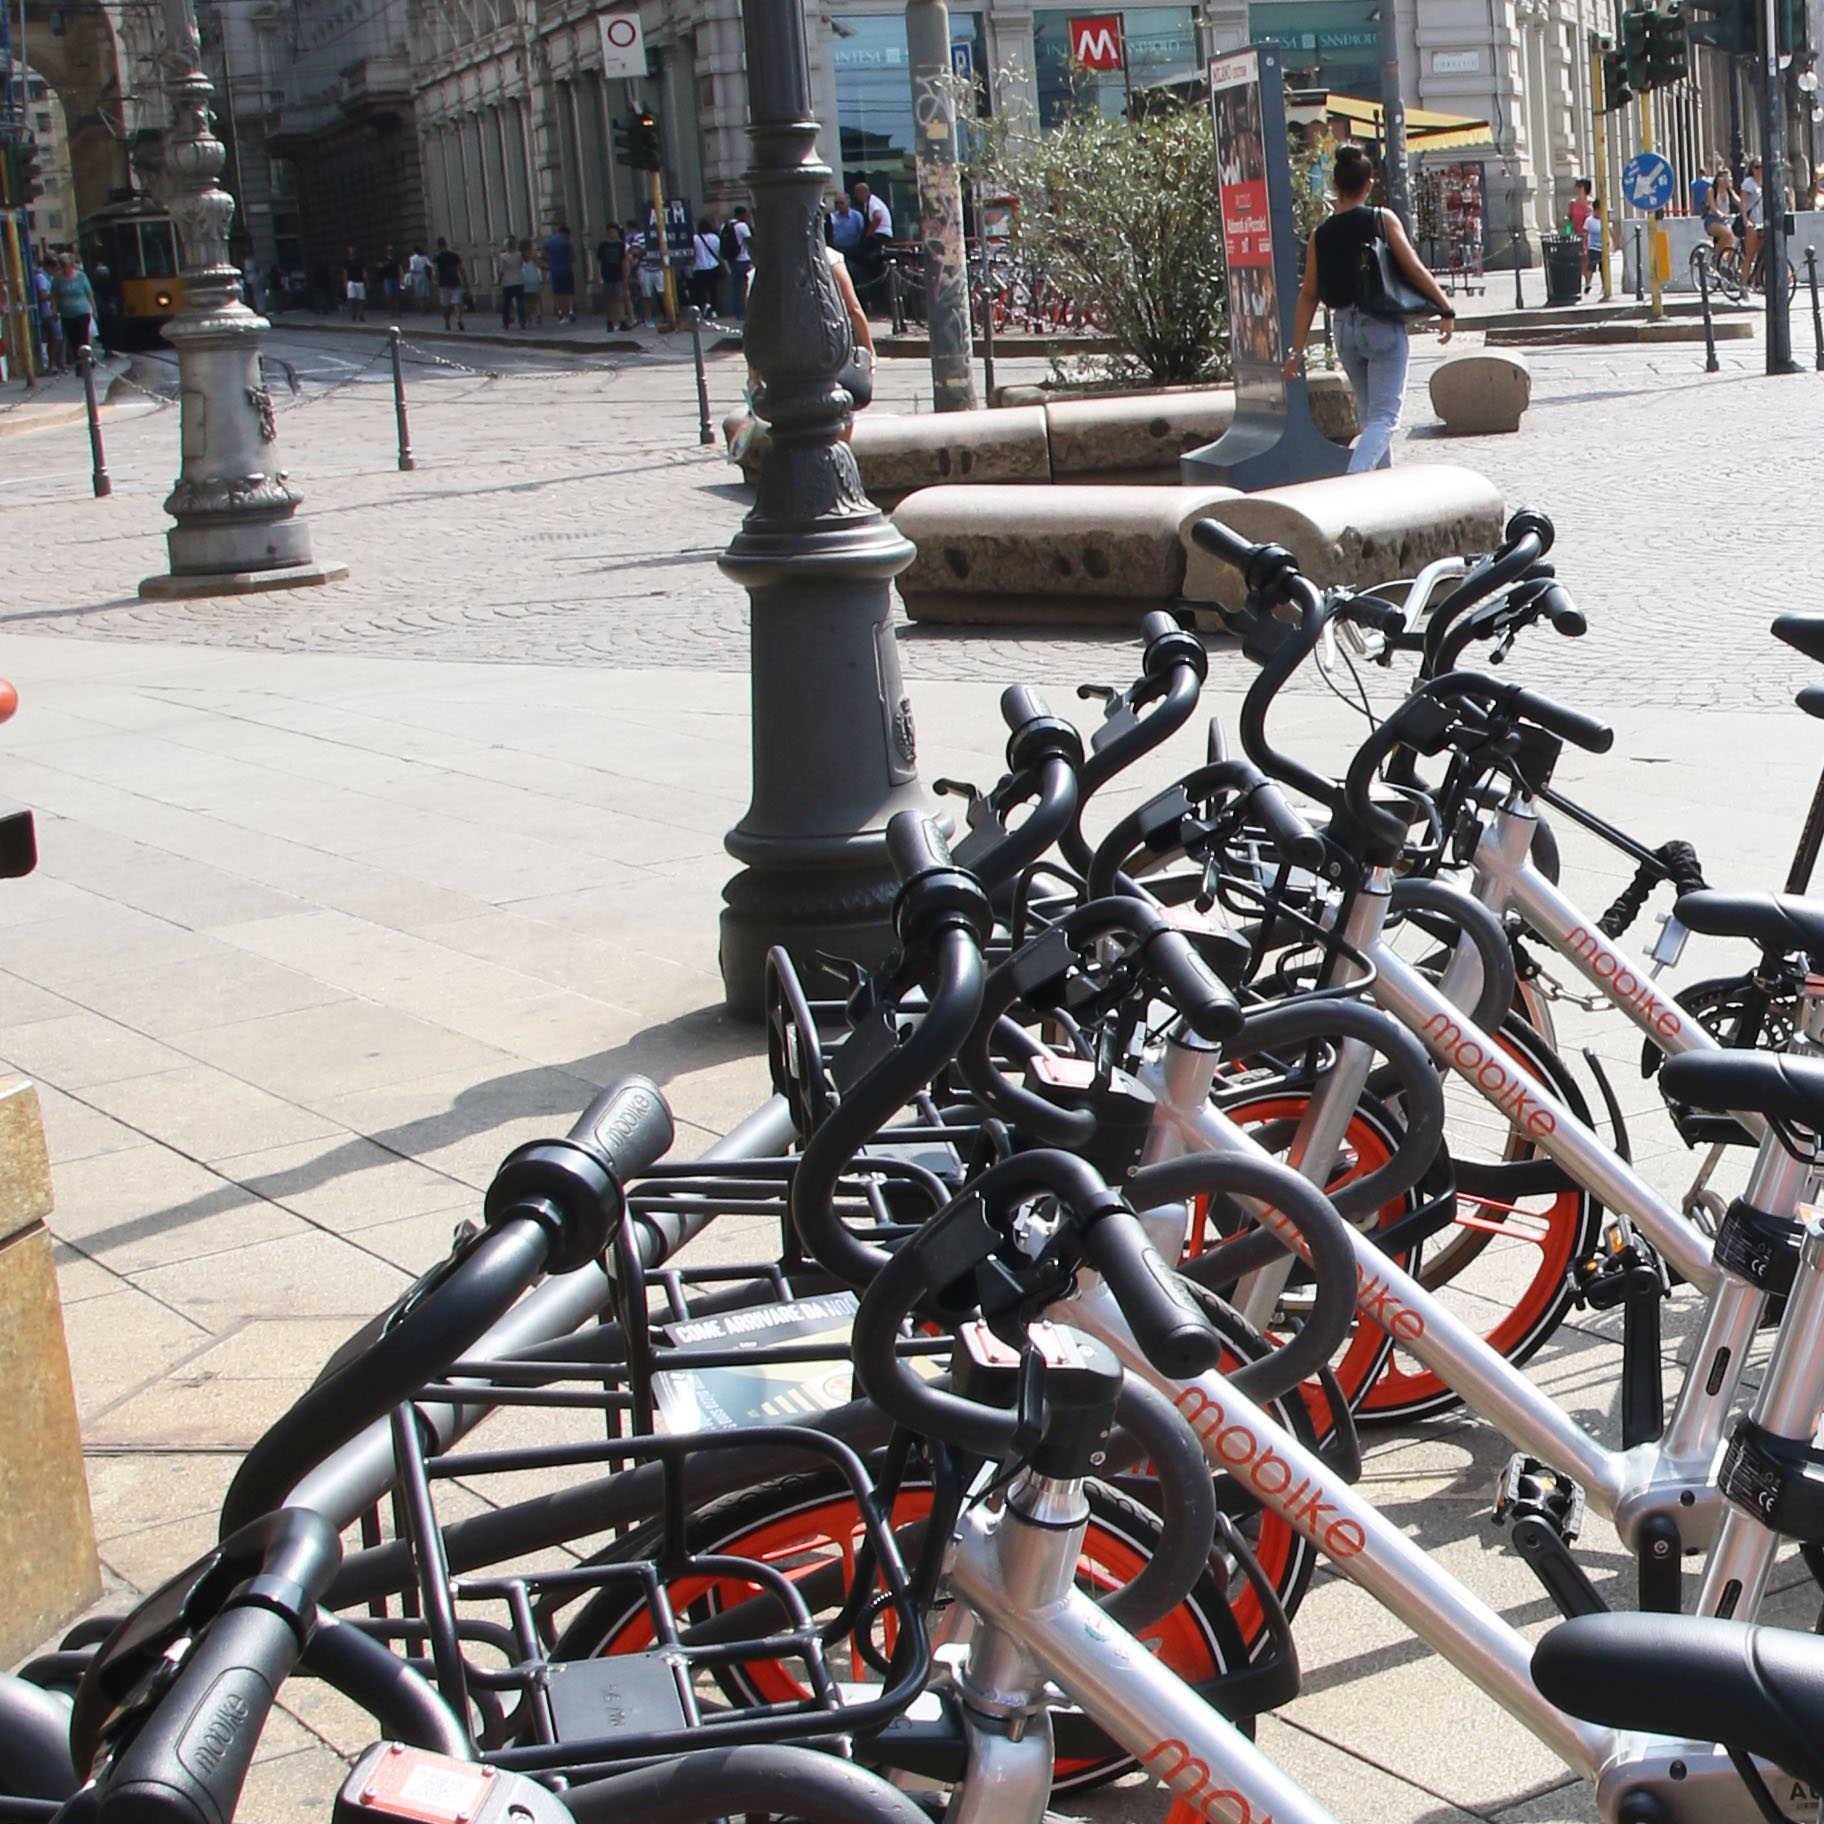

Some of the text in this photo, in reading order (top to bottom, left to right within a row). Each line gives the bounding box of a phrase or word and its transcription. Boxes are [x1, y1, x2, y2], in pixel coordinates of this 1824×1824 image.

[956, 49, 968, 77] P
[1077, 28, 1119, 62] M
[1563, 926, 1682, 1038] mobike
[1422, 1012, 1557, 1138] mobike
[606, 1094, 650, 1149] mobike
[675, 1319, 727, 1344] COME
[723, 1304, 805, 1336] ARRIVARE
[801, 1303, 827, 1320] DA
[1174, 1386, 1366, 1558] mobike
[193, 1693, 249, 1776] mobike
